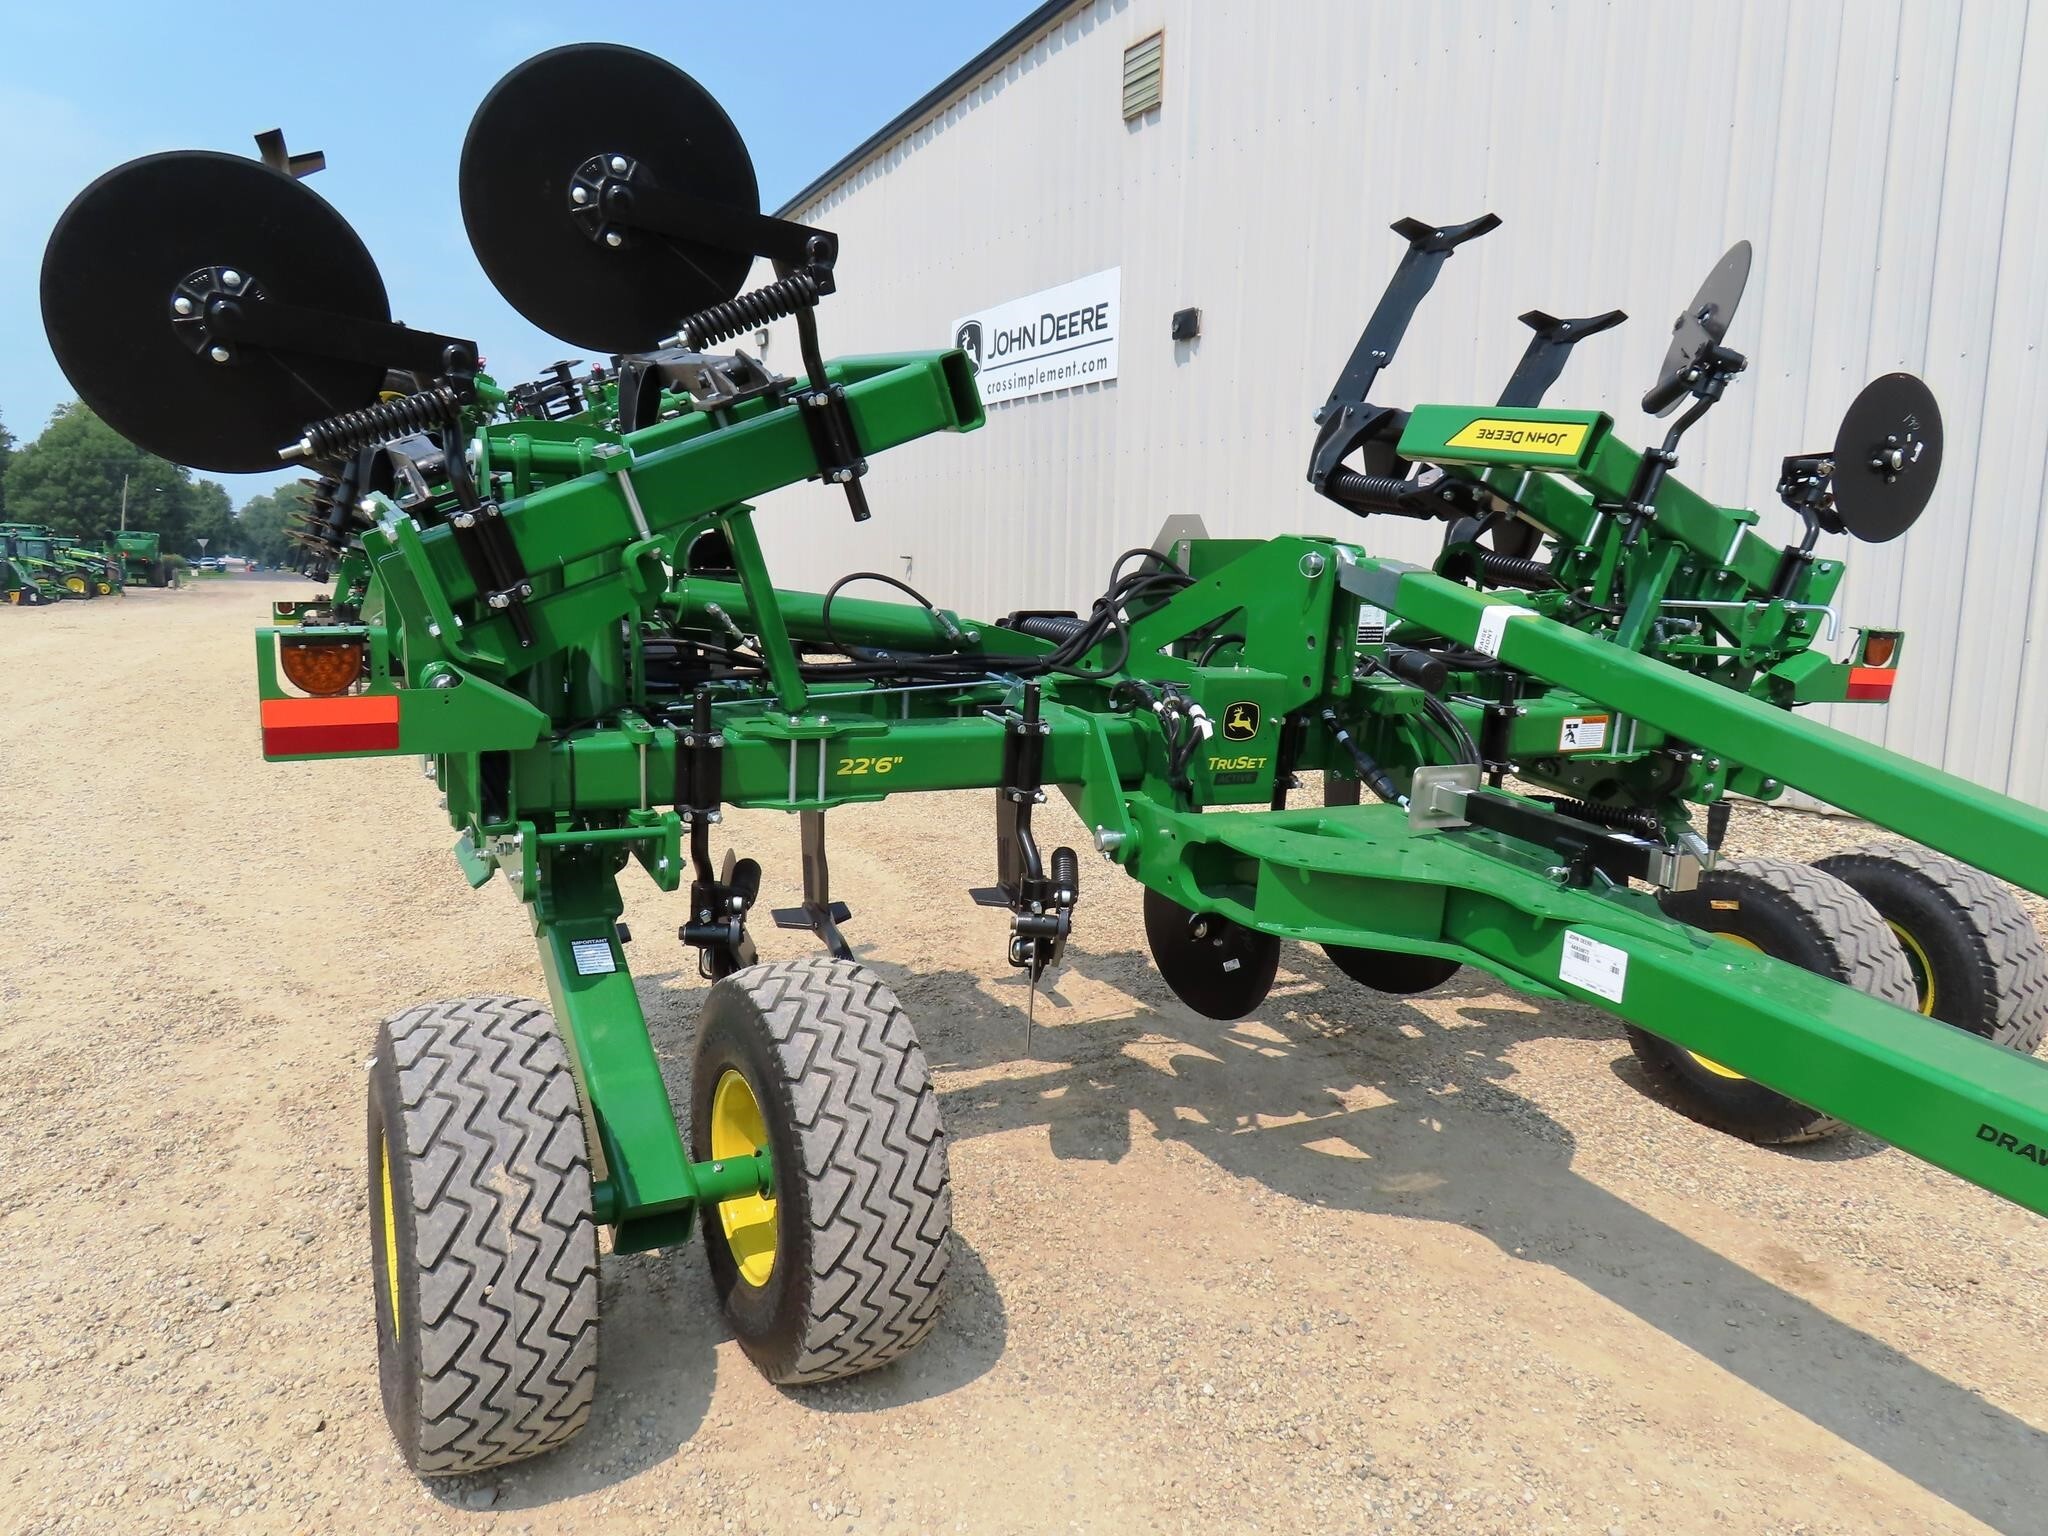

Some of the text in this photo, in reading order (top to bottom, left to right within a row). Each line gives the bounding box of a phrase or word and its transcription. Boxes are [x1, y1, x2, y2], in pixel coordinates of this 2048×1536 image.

[987, 302, 1109, 359] JOHN DEERE
[986, 356, 1108, 394] crossimplement.com
[1475, 428, 1568, 447] JOHN DEERE
[836, 756, 903, 776] 22'6"
[571, 938, 608, 946] IMPORTANT
